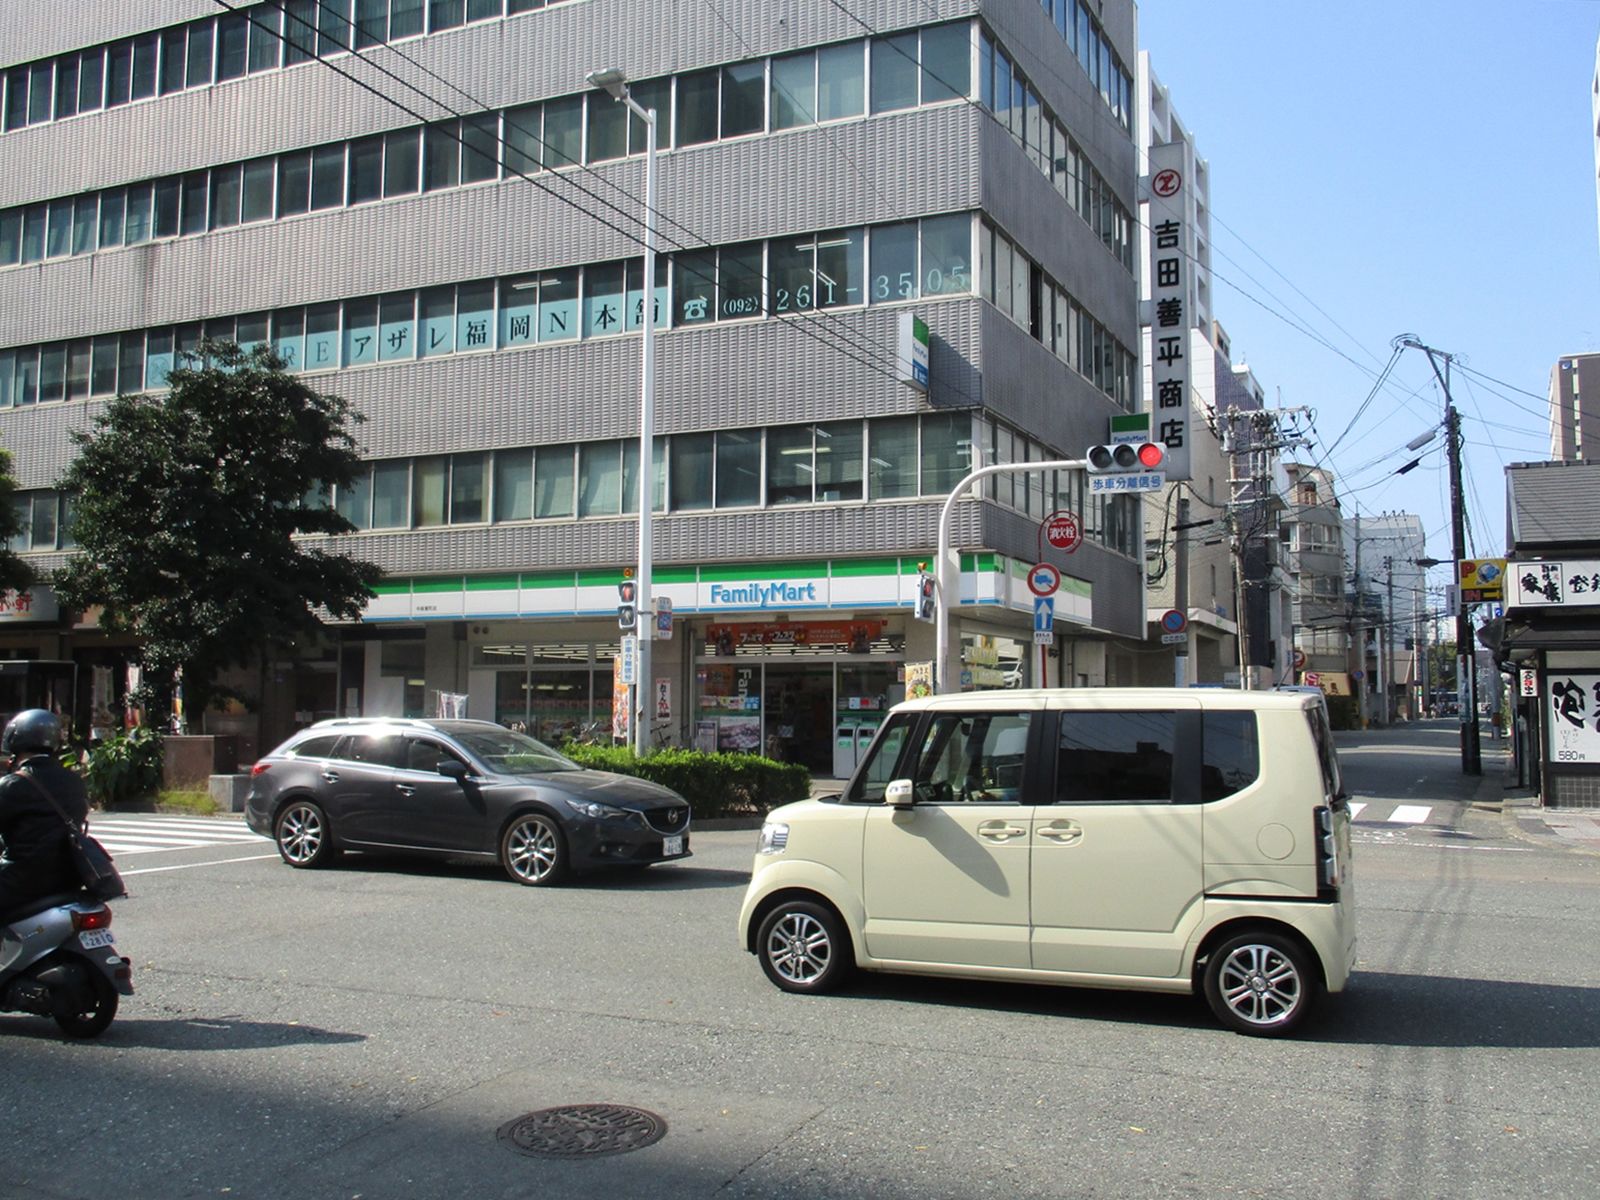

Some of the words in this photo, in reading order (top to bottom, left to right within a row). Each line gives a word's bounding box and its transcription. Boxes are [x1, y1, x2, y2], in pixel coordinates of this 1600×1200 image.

[1154, 218, 1185, 449] 吉田善平商店
[1092, 475, 1162, 491] 歩車分離信号
[1461, 561, 1477, 578] P
[711, 582, 816, 607] FamilyMart
